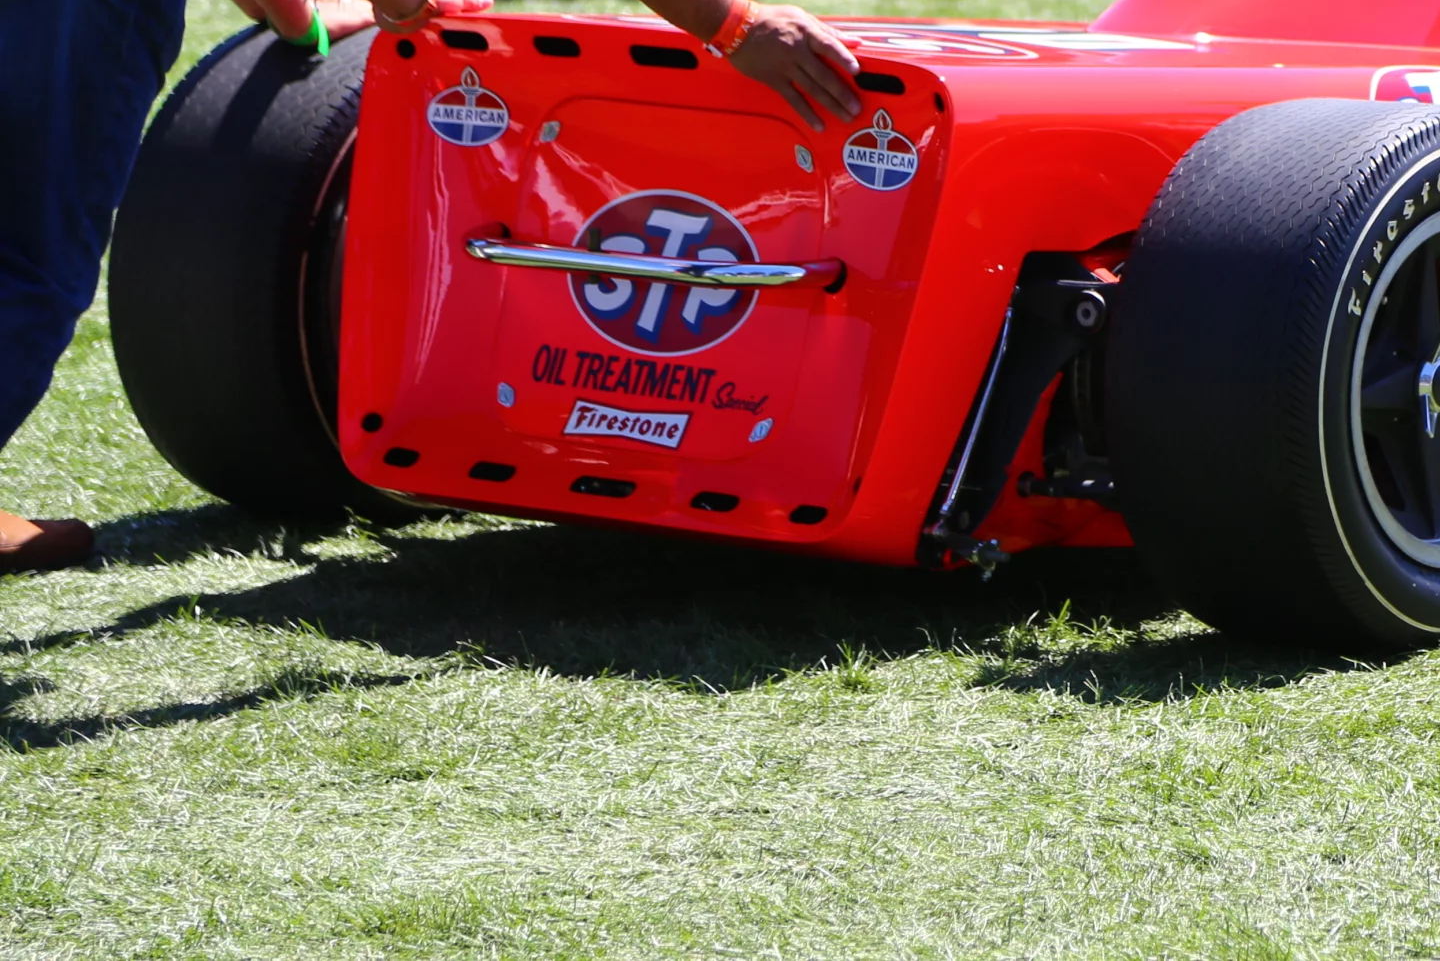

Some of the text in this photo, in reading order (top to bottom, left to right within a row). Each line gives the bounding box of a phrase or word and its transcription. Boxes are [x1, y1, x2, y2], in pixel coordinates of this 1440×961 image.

[434, 106, 506, 124] AMERICAN
[847, 148, 915, 169] AMERICAN
[583, 208, 740, 344] STP
[532, 344, 568, 386] OIL
[572, 351, 716, 404] TREATMENT
[573, 405, 679, 440] Firestone
